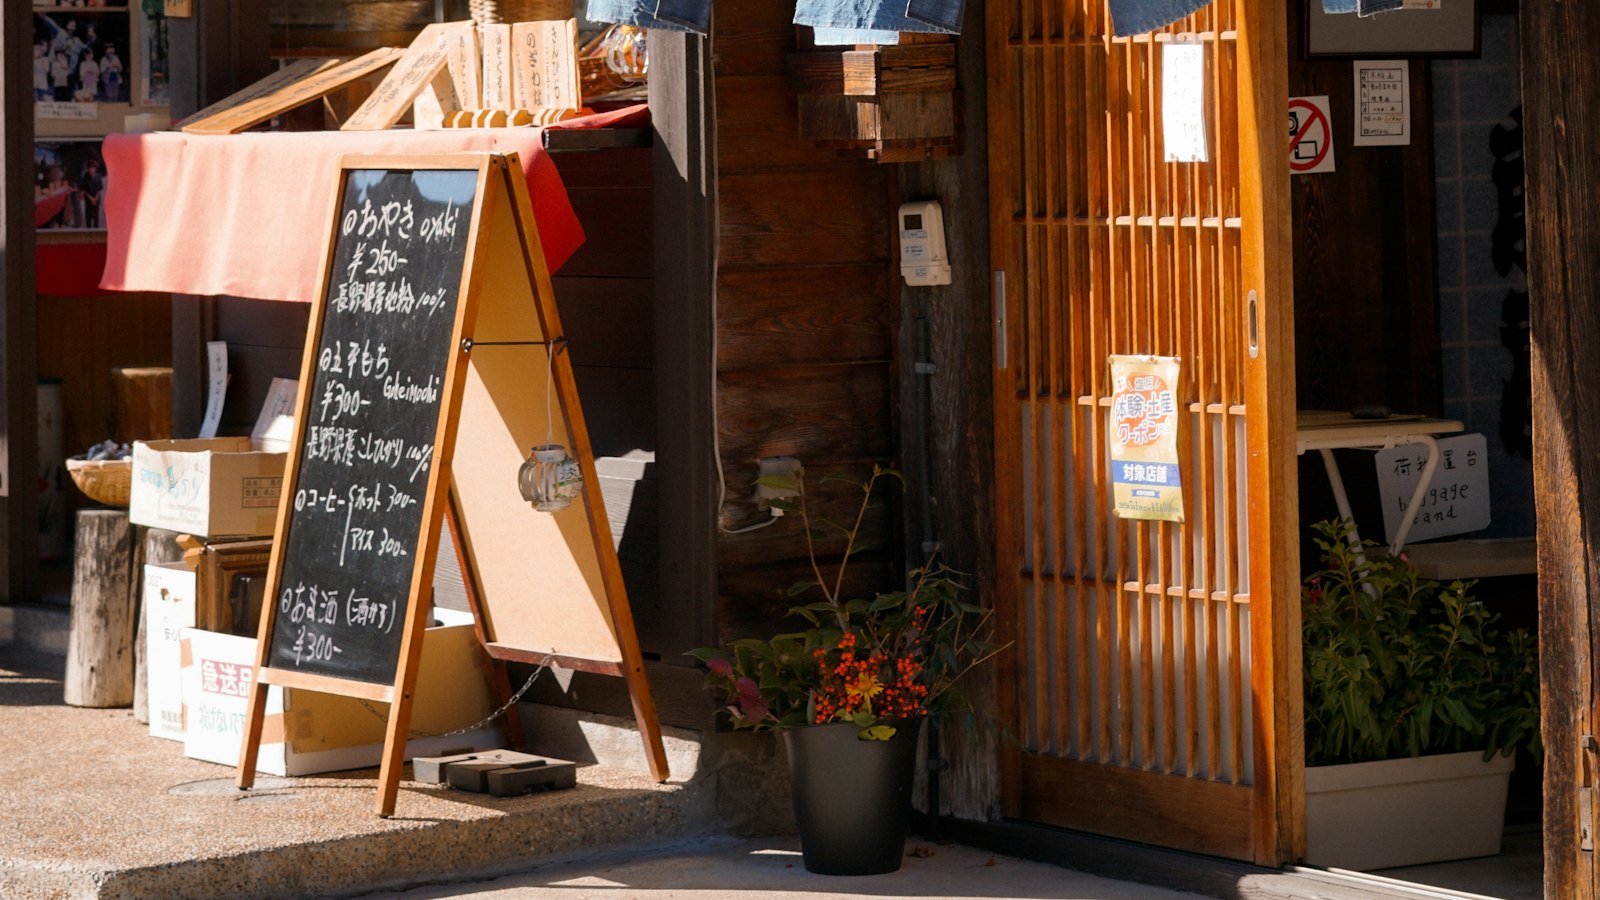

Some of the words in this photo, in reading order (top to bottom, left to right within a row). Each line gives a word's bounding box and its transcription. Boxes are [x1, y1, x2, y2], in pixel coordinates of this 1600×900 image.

[420, 196, 460, 243] oyaki
[1118, 419, 1160, 445] クーポン
[1122, 463, 1168, 484] 対象店舗
[1398, 483, 1469, 512] bgage
[350, 527, 374, 551] アイス
